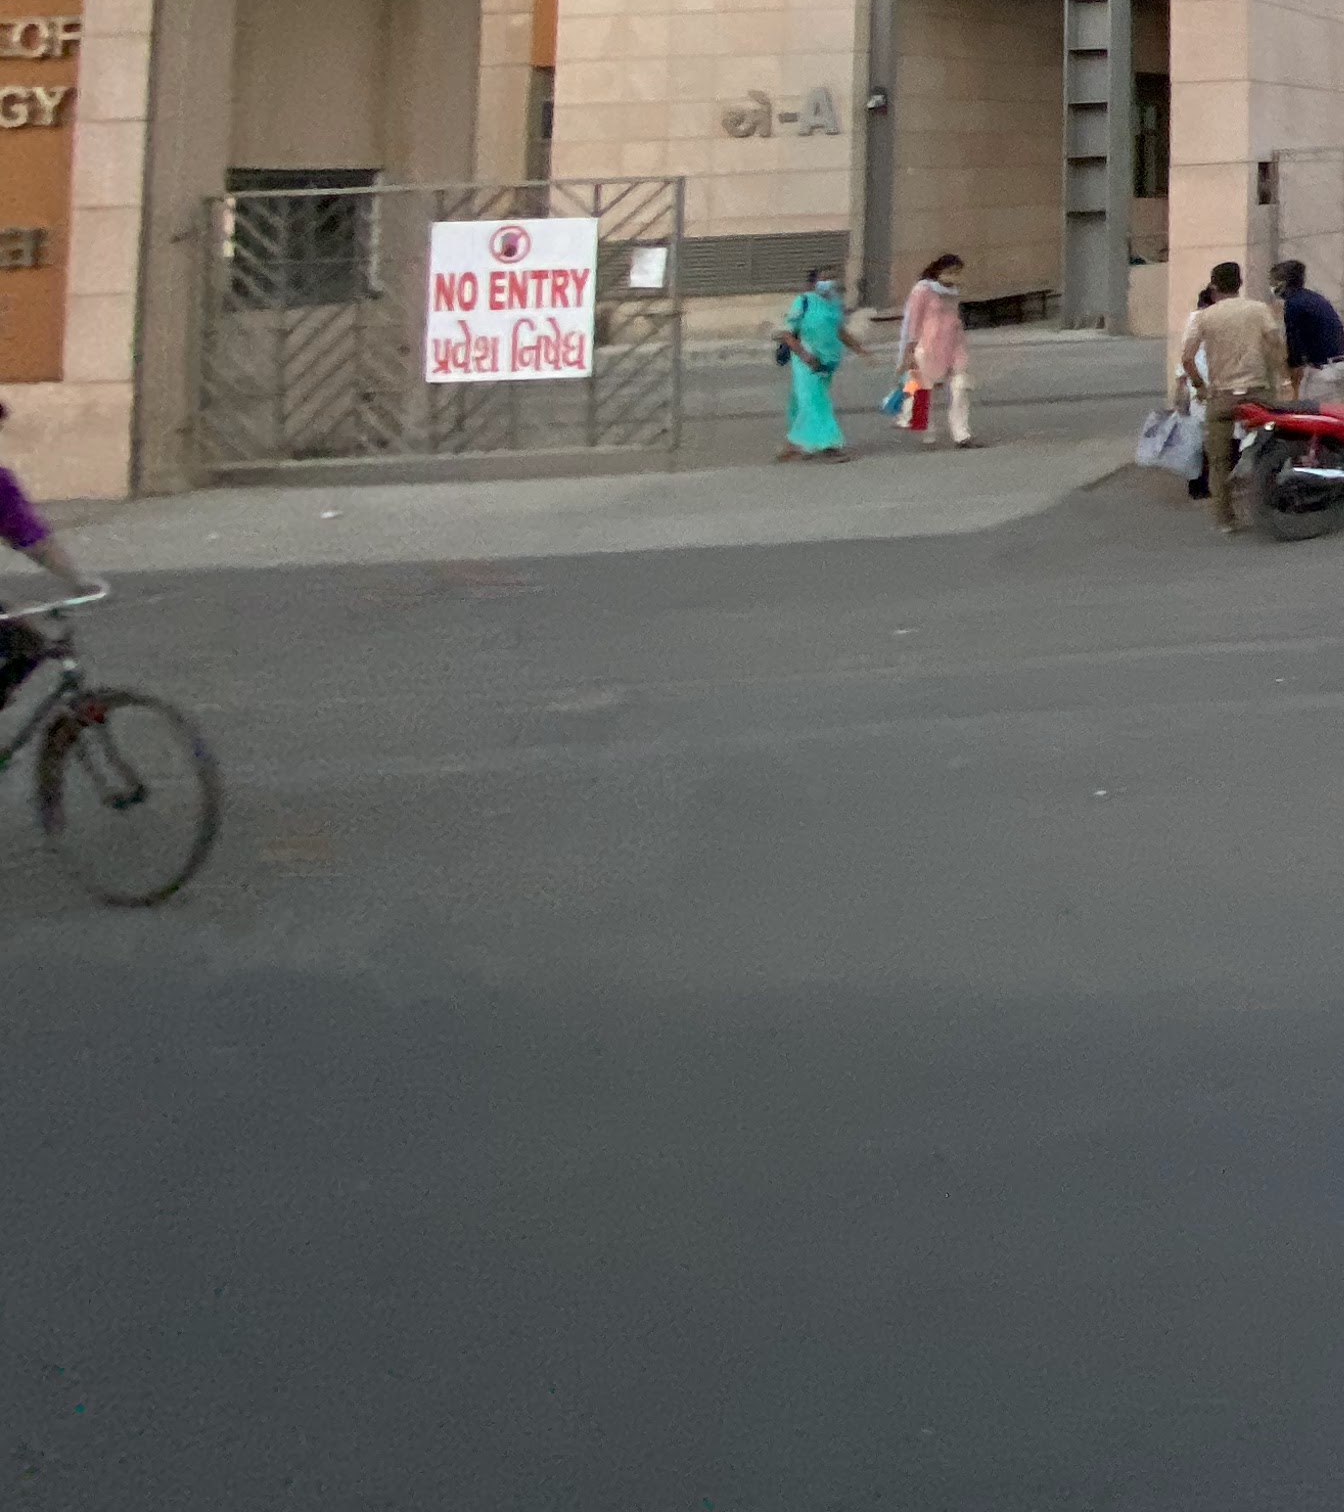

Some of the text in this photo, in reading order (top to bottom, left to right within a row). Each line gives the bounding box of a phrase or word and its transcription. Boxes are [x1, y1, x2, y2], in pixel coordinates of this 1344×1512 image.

[435, 268, 590, 311] NO ENTRY
[433, 317, 586, 374] પ્રવેશ નિષેધ
